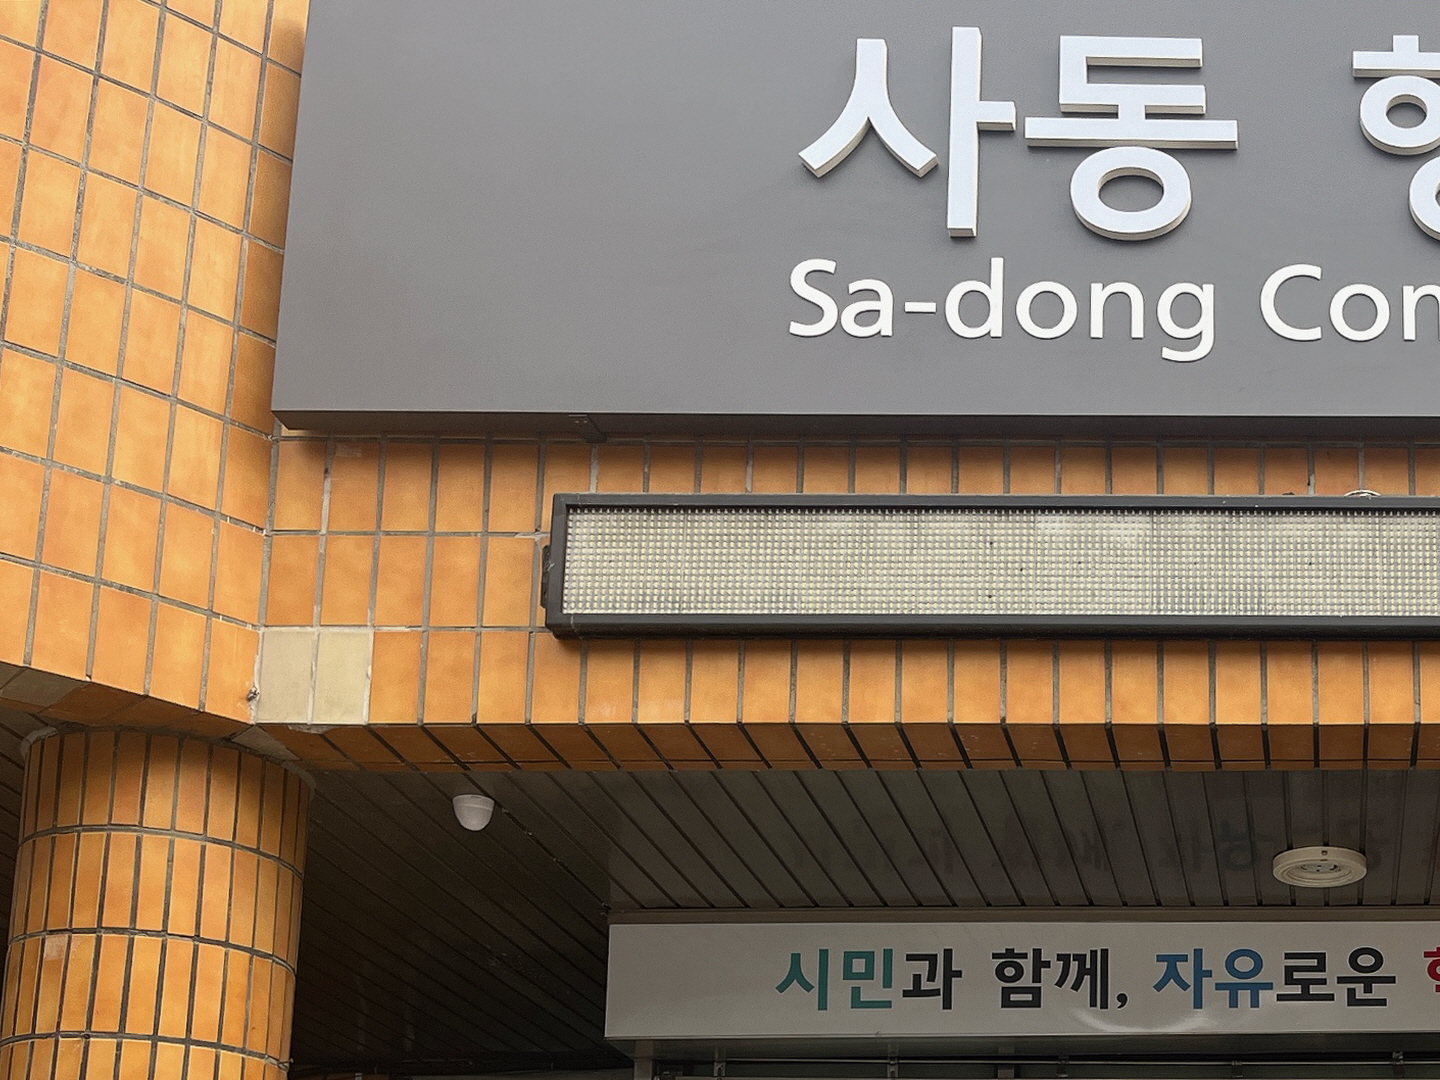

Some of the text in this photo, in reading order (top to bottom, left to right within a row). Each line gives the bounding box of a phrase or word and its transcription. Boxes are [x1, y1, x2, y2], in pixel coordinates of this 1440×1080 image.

[798, 26, 1239, 242] 사동
[787, 256, 1217, 363] Sa-dong
[775, 948, 963, 1012] 시민과
[991, 947, 1129, 1010] 함께,
[1152, 946, 1397, 1011] 자유로운
